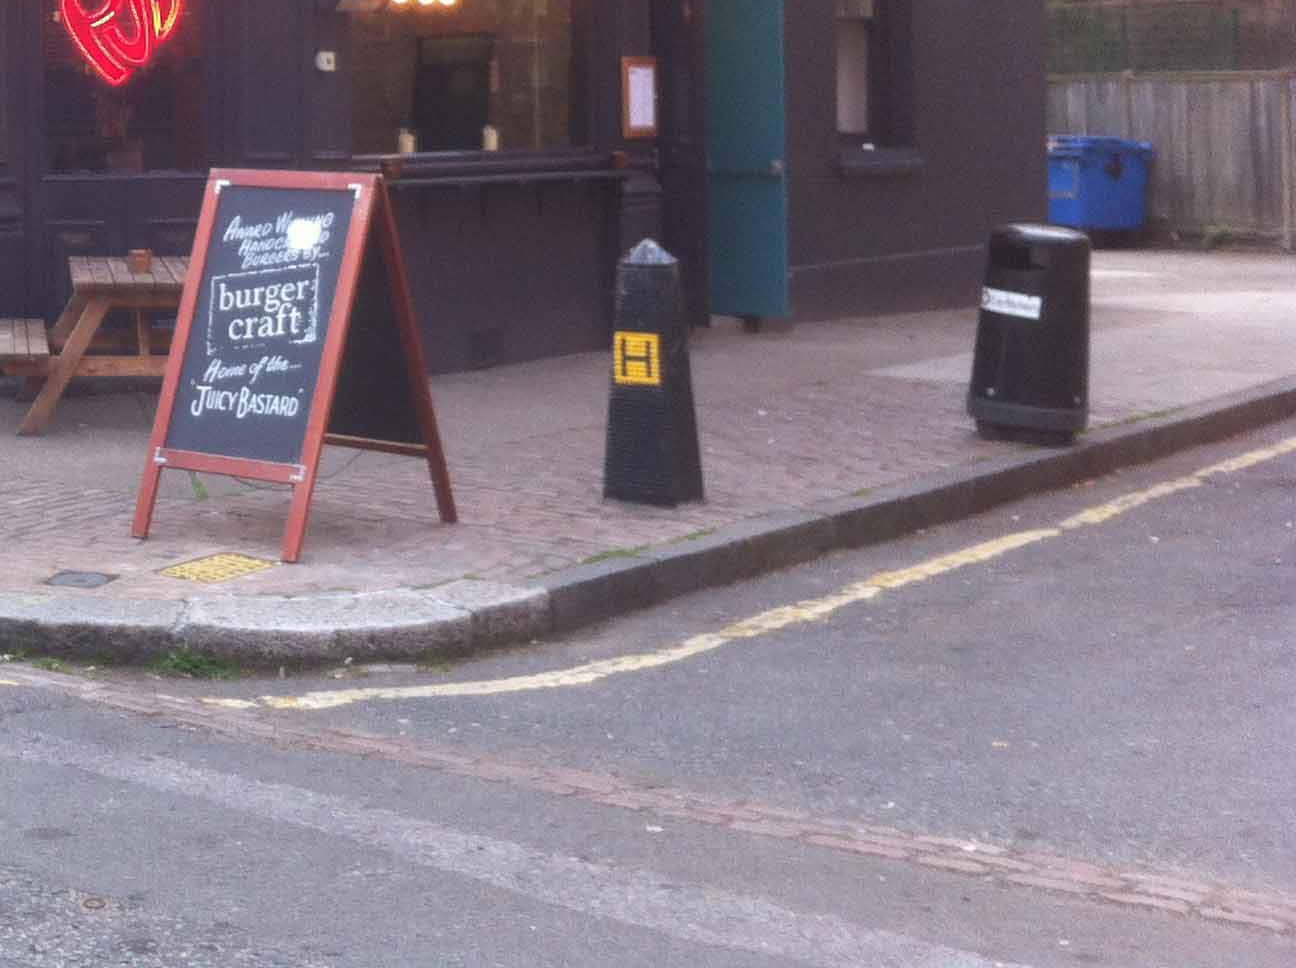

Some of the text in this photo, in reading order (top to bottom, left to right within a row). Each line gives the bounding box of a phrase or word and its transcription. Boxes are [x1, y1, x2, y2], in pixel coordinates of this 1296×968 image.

[218, 279, 310, 313] burger
[227, 302, 303, 341] craft
[202, 358, 248, 383] Home
[248, 355, 269, 385] of
[621, 337, 653, 379] H
